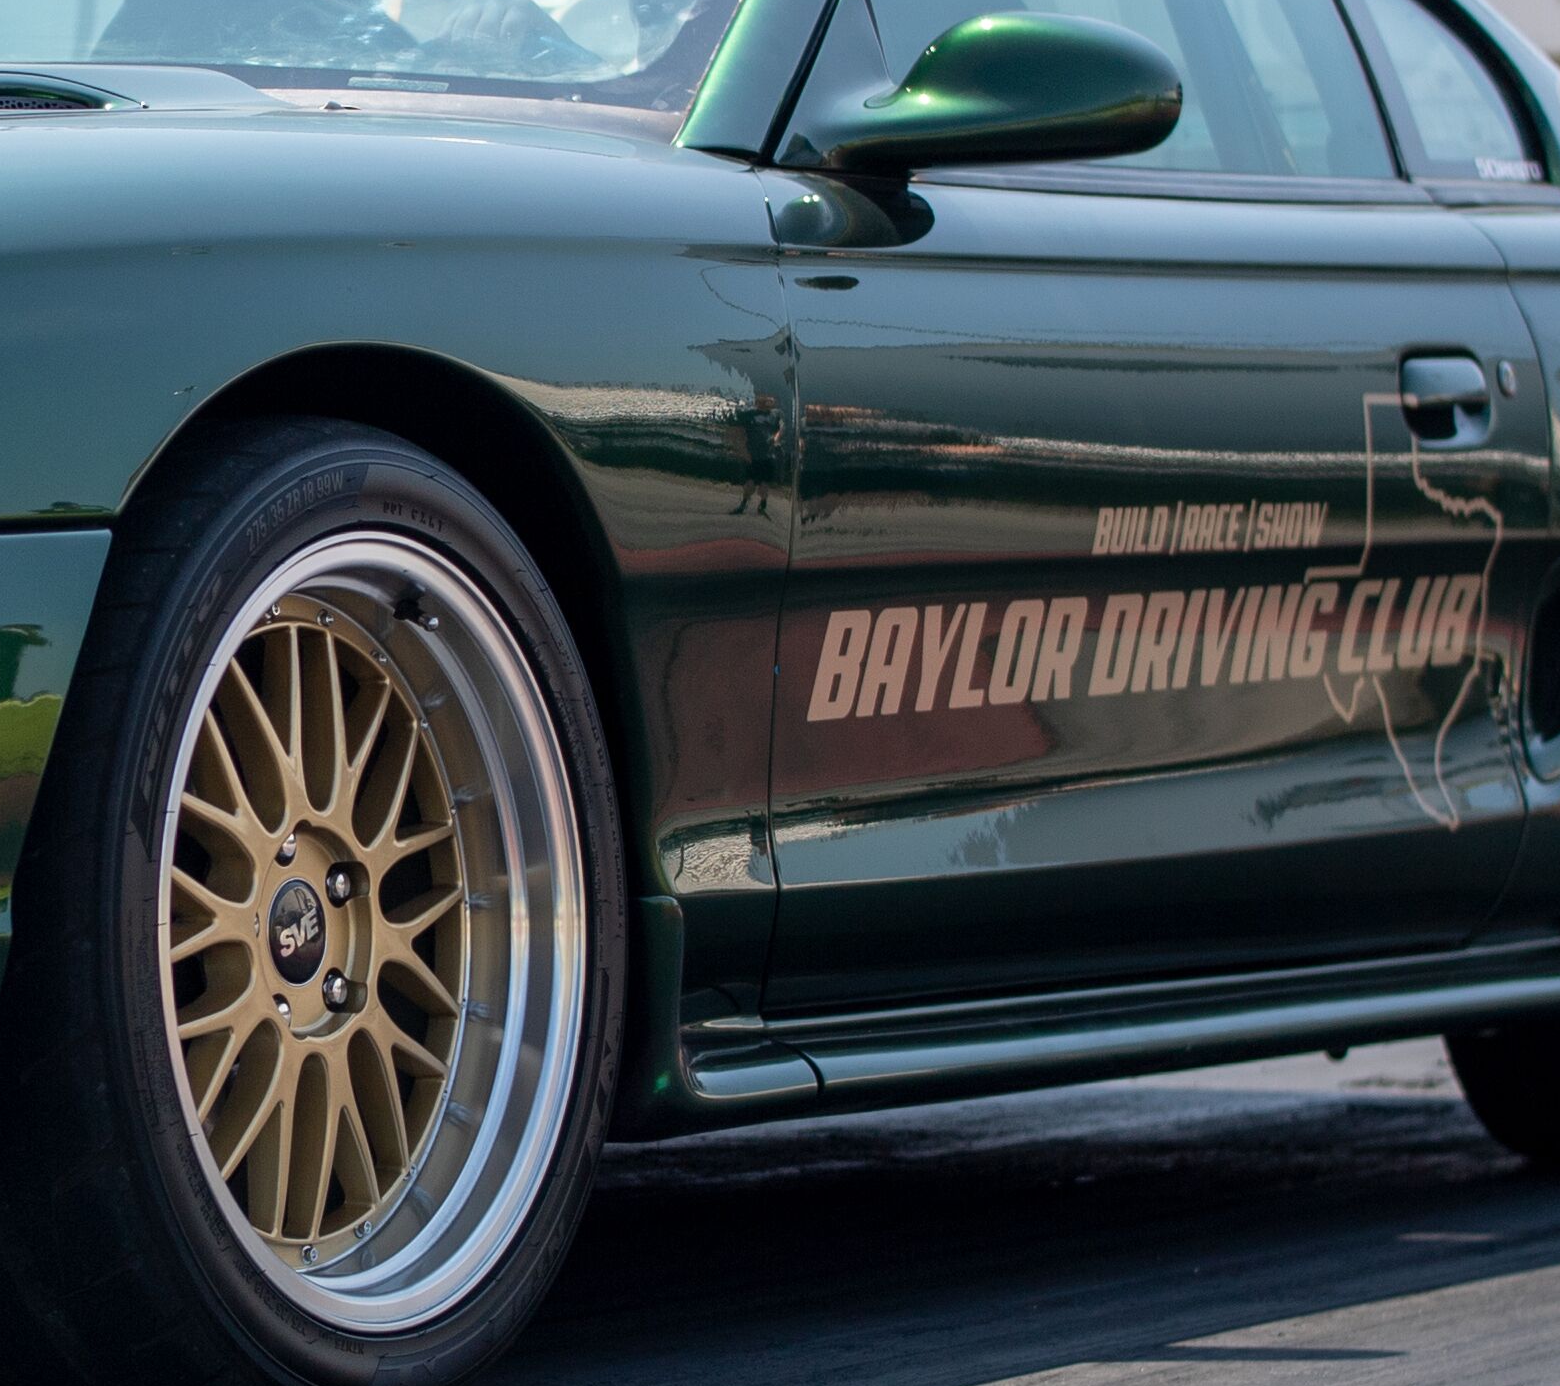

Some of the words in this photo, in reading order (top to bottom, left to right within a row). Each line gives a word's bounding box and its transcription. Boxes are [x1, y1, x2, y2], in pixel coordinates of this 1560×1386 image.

[1091, 505, 1170, 555] BUILD
[1180, 502, 1244, 552] RACE
[1253, 501, 1329, 549] SHOW
[806, 596, 1088, 722] BAYLOR
[1088, 579, 1340, 697] DRIVING
[1337, 573, 1482, 674] CLUB
[279, 907, 320, 959] SVE
